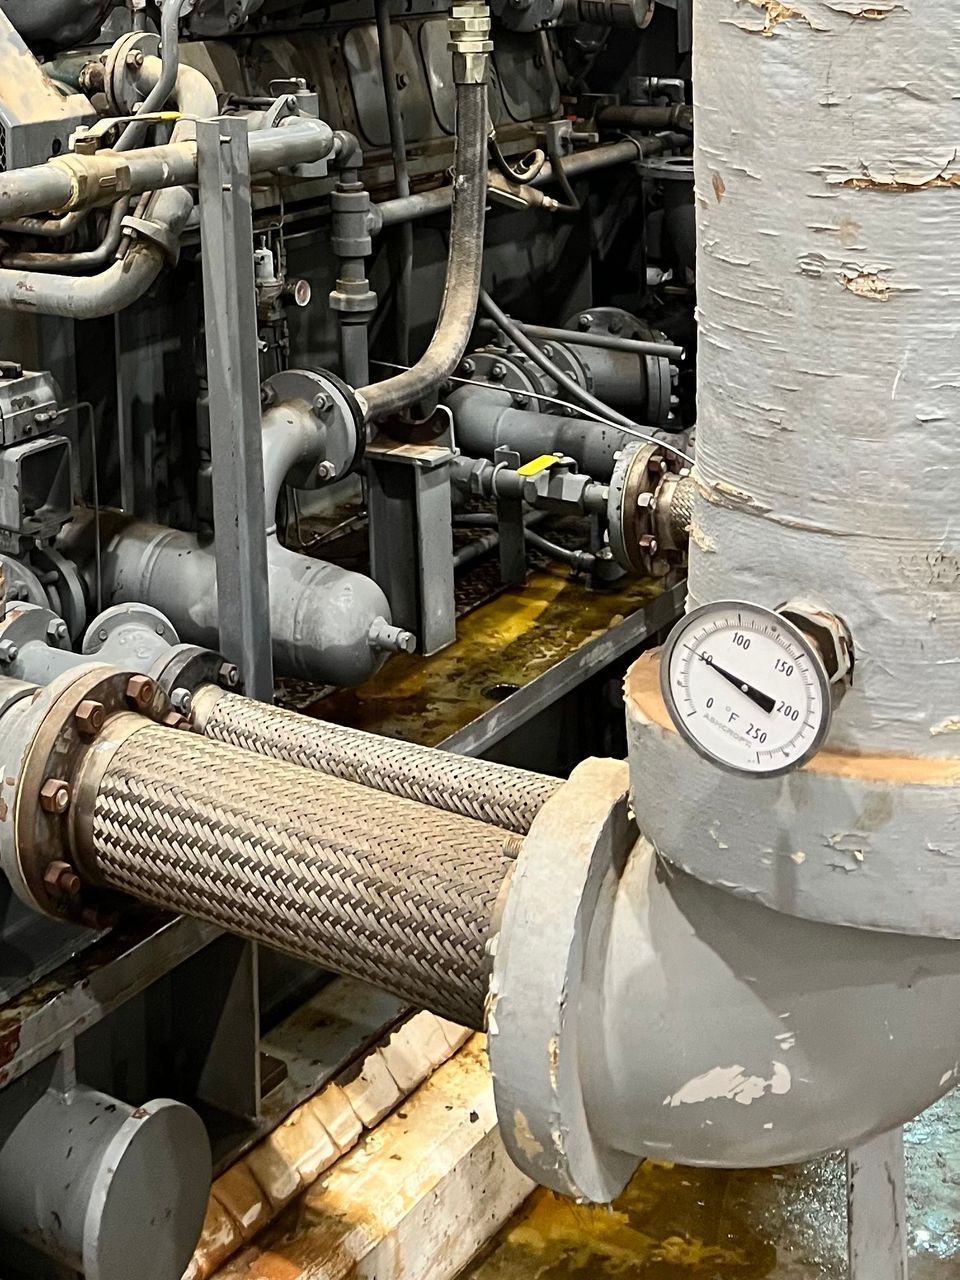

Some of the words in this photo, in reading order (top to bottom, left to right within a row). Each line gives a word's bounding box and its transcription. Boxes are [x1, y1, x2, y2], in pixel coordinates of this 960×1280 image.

[732, 631, 751, 650] 100
[699, 651, 714, 665] 50
[774, 658, 794, 677] 150
[706, 697, 714, 709] 0
[776, 701, 800, 722] 200
[745, 723, 768, 744] 250
